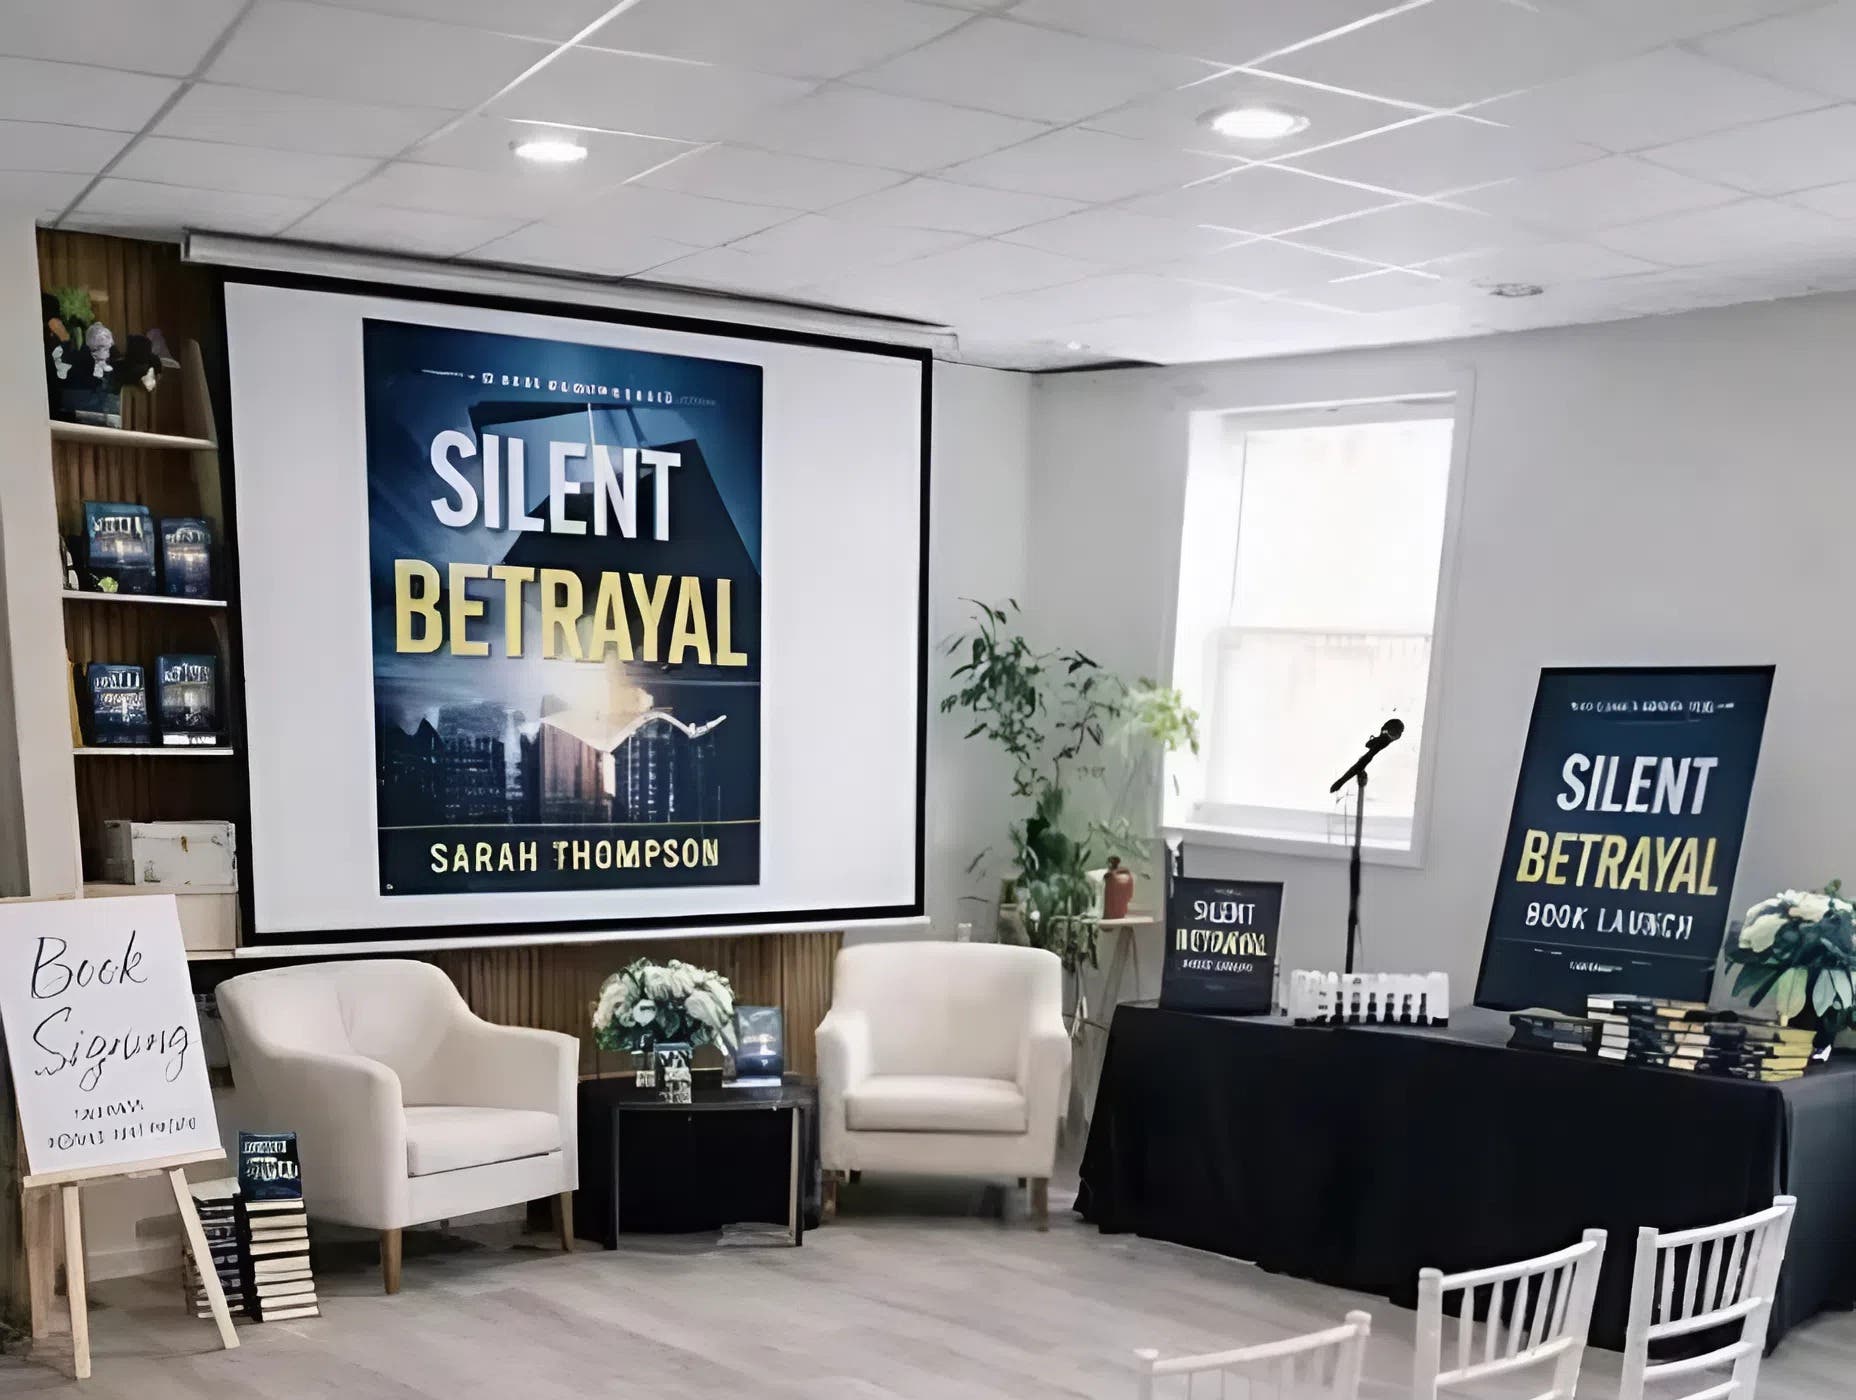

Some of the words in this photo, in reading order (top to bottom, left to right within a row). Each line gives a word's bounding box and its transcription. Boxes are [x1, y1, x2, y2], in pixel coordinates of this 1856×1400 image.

[430, 430, 682, 542] SILENT
[394, 559, 748, 666] BETRAYAL
[1556, 753, 1718, 815] SILENT
[430, 841, 538, 873] SARAH
[553, 838, 719, 871] THOMPSON
[1516, 829, 1718, 896] BETRAYAL
[1525, 902, 1588, 930] BOOK
[31, 930, 148, 999] Book
